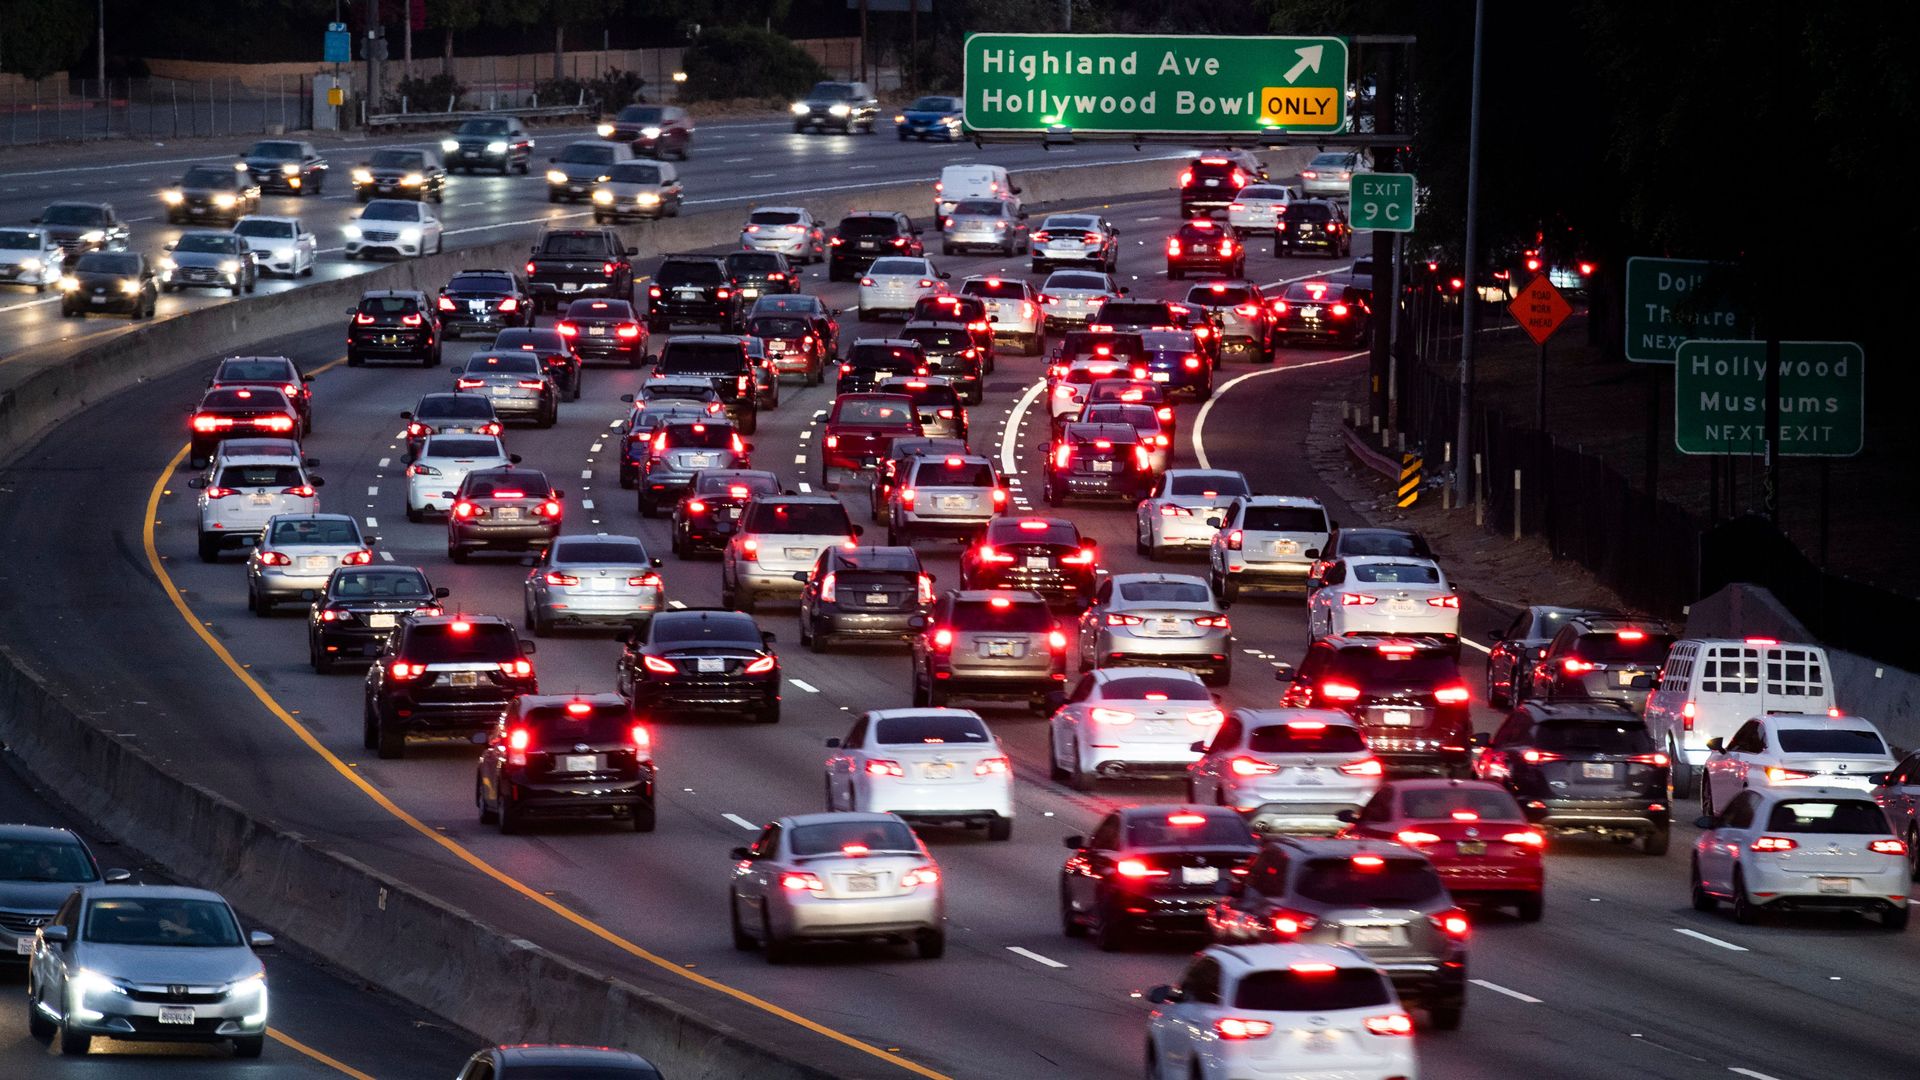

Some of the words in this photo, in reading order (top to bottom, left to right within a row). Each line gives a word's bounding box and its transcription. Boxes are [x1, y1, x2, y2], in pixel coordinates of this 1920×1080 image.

[983, 49, 1137, 82] Highland
[1157, 51, 1220, 75] Ave
[982, 89, 1156, 121] Hollywood
[1176, 91, 1254, 115] Bowl
[1268, 97, 1331, 115] ONLY
[1363, 182, 1401, 197] EXIT
[1531, 290, 1552, 300] ROAD
[1530, 304, 1552, 314] WORK
[1529, 318, 1553, 328] AHEAD
[1642, 333, 1687, 349] NEX
[1691, 355, 1848, 381] Hollywood
[1700, 391, 1838, 413] Musums
[1705, 425, 1766, 441] NEXT
[1779, 425, 1832, 441] EXIT
